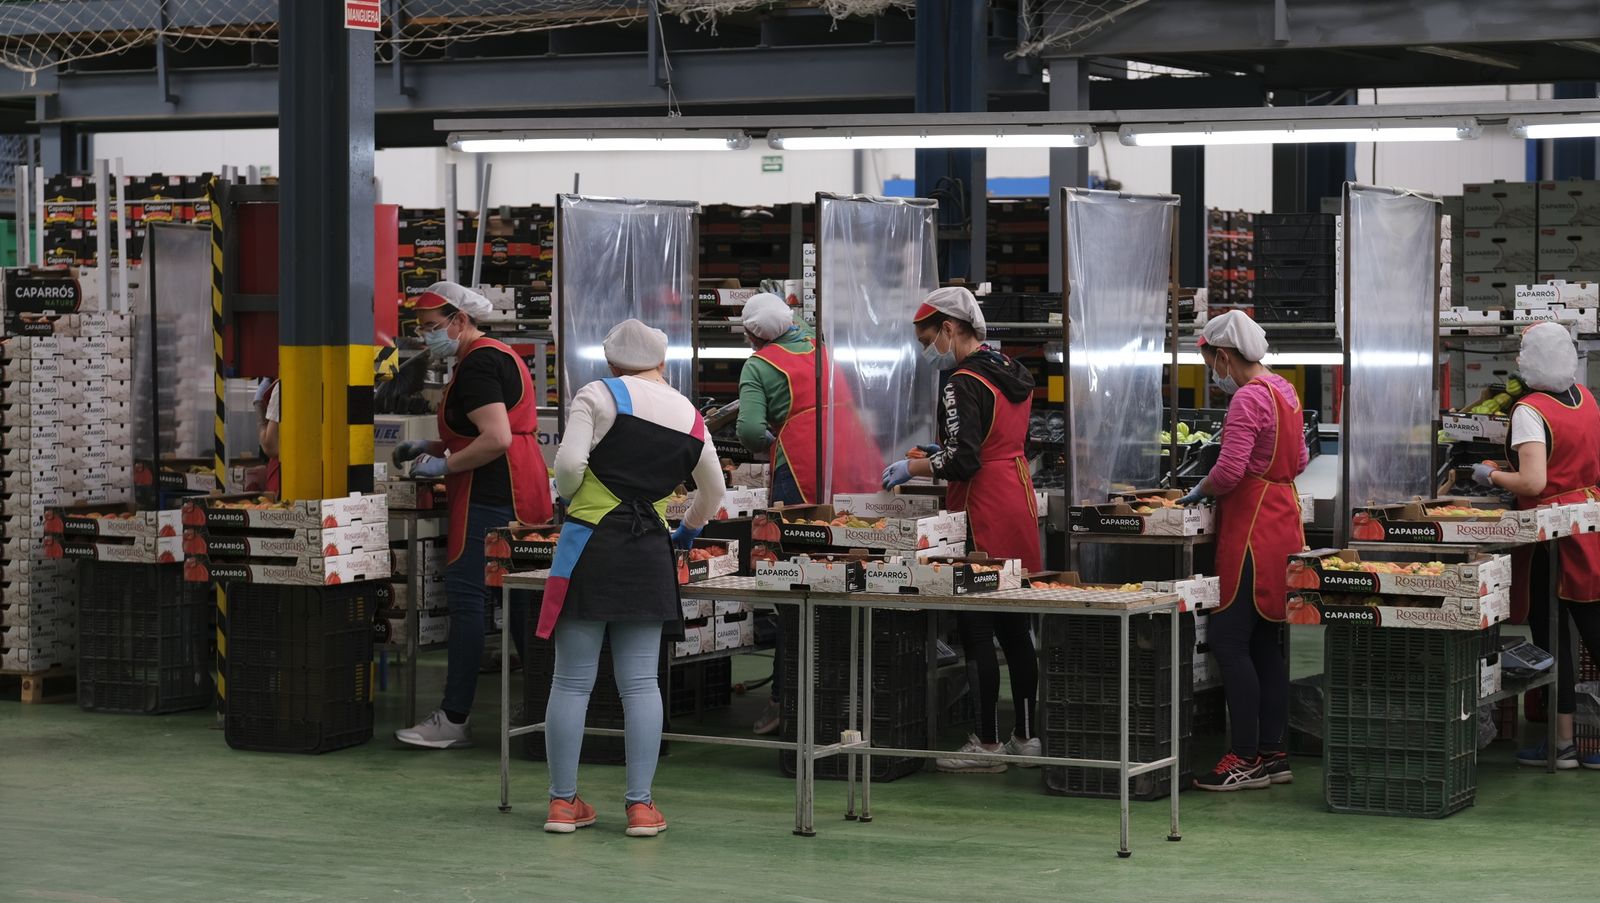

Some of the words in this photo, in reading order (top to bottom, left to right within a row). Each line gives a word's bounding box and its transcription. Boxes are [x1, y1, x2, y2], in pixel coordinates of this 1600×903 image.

[347, 8, 379, 23] MANGUERA
[415, 239, 445, 247] Caparrós
[15, 284, 74, 298] CAPARRÓS
[1444, 423, 1480, 431] CAPARRÓS
[715, 446, 748, 454] APARRÓS
[865, 502, 903, 512] Rosamary
[208, 513, 244, 521] CAPARRÓS
[65, 522, 95, 530] CAPARRÓS
[1100, 518, 1140, 526] CAPARRÓS
[784, 529, 826, 538] CAPARRÓS
[845, 529, 899, 543] Rosamary
[1388, 527, 1435, 536] CAPARRÓS
[1456, 525, 1518, 539] Rosamary
[209, 542, 245, 550] CAPARRÓS
[514, 546, 552, 554] CAPARRÓS
[64, 547, 94, 555] CAPARRÓS
[211, 569, 247, 577] CAPARRÓS
[757, 569, 799, 577] CAPARRÓS
[868, 570, 908, 579] CAPARRÓS
[973, 573, 998, 584] CAPARRÓS
[1324, 576, 1373, 586] CAPARRÓS
[1395, 575, 1458, 590] Rosamary
[1324, 611, 1374, 620] CAPARRÓS
[1396, 609, 1459, 624] Rosamary
